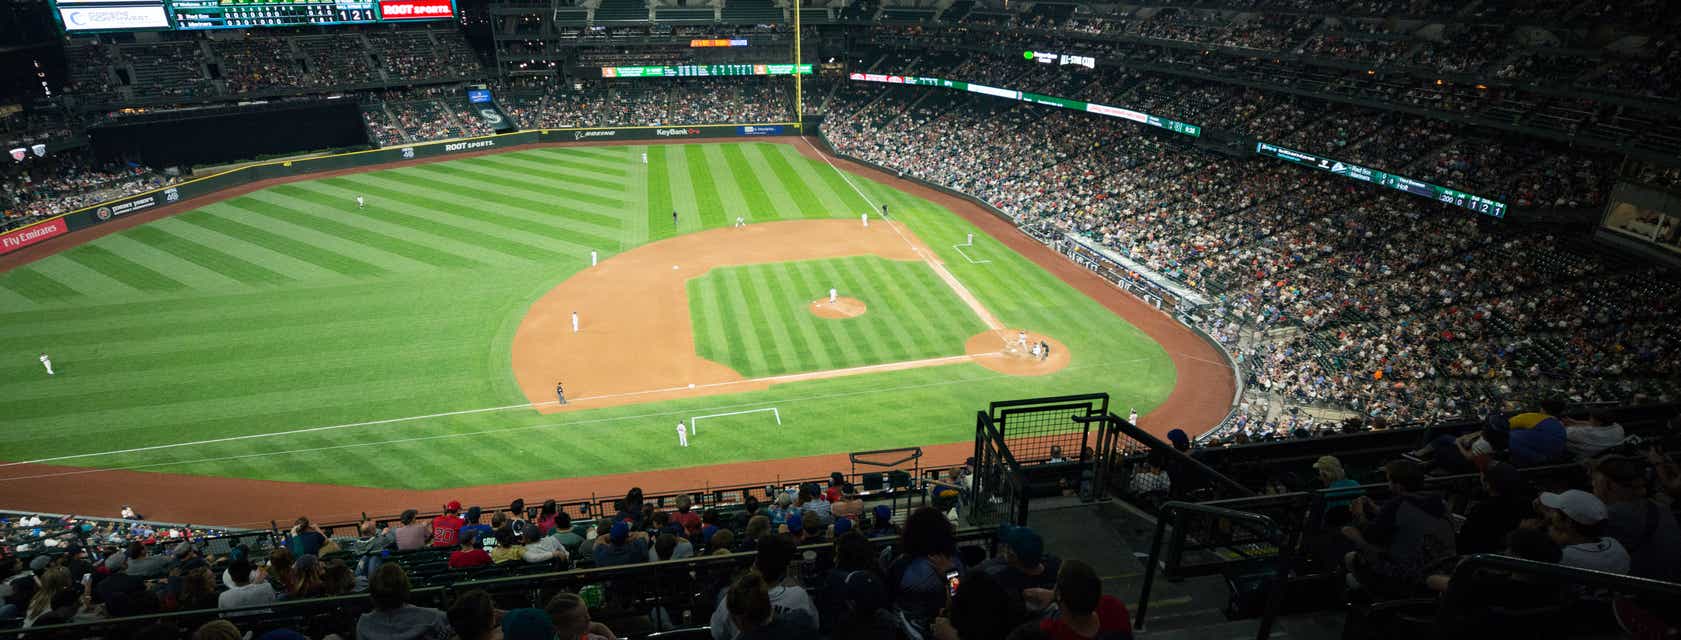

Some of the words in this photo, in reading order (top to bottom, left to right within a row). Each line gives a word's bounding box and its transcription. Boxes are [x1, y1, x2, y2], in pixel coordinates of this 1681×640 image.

[384, 5, 412, 14] ROOT
[340, 11, 346, 20] 1
[352, 10, 360, 20] 2
[366, 10, 371, 19] 1
[446, 143, 467, 151] ROOT
[2, 237, 20, 247] Fly
[20, 225, 56, 241] Emirates
